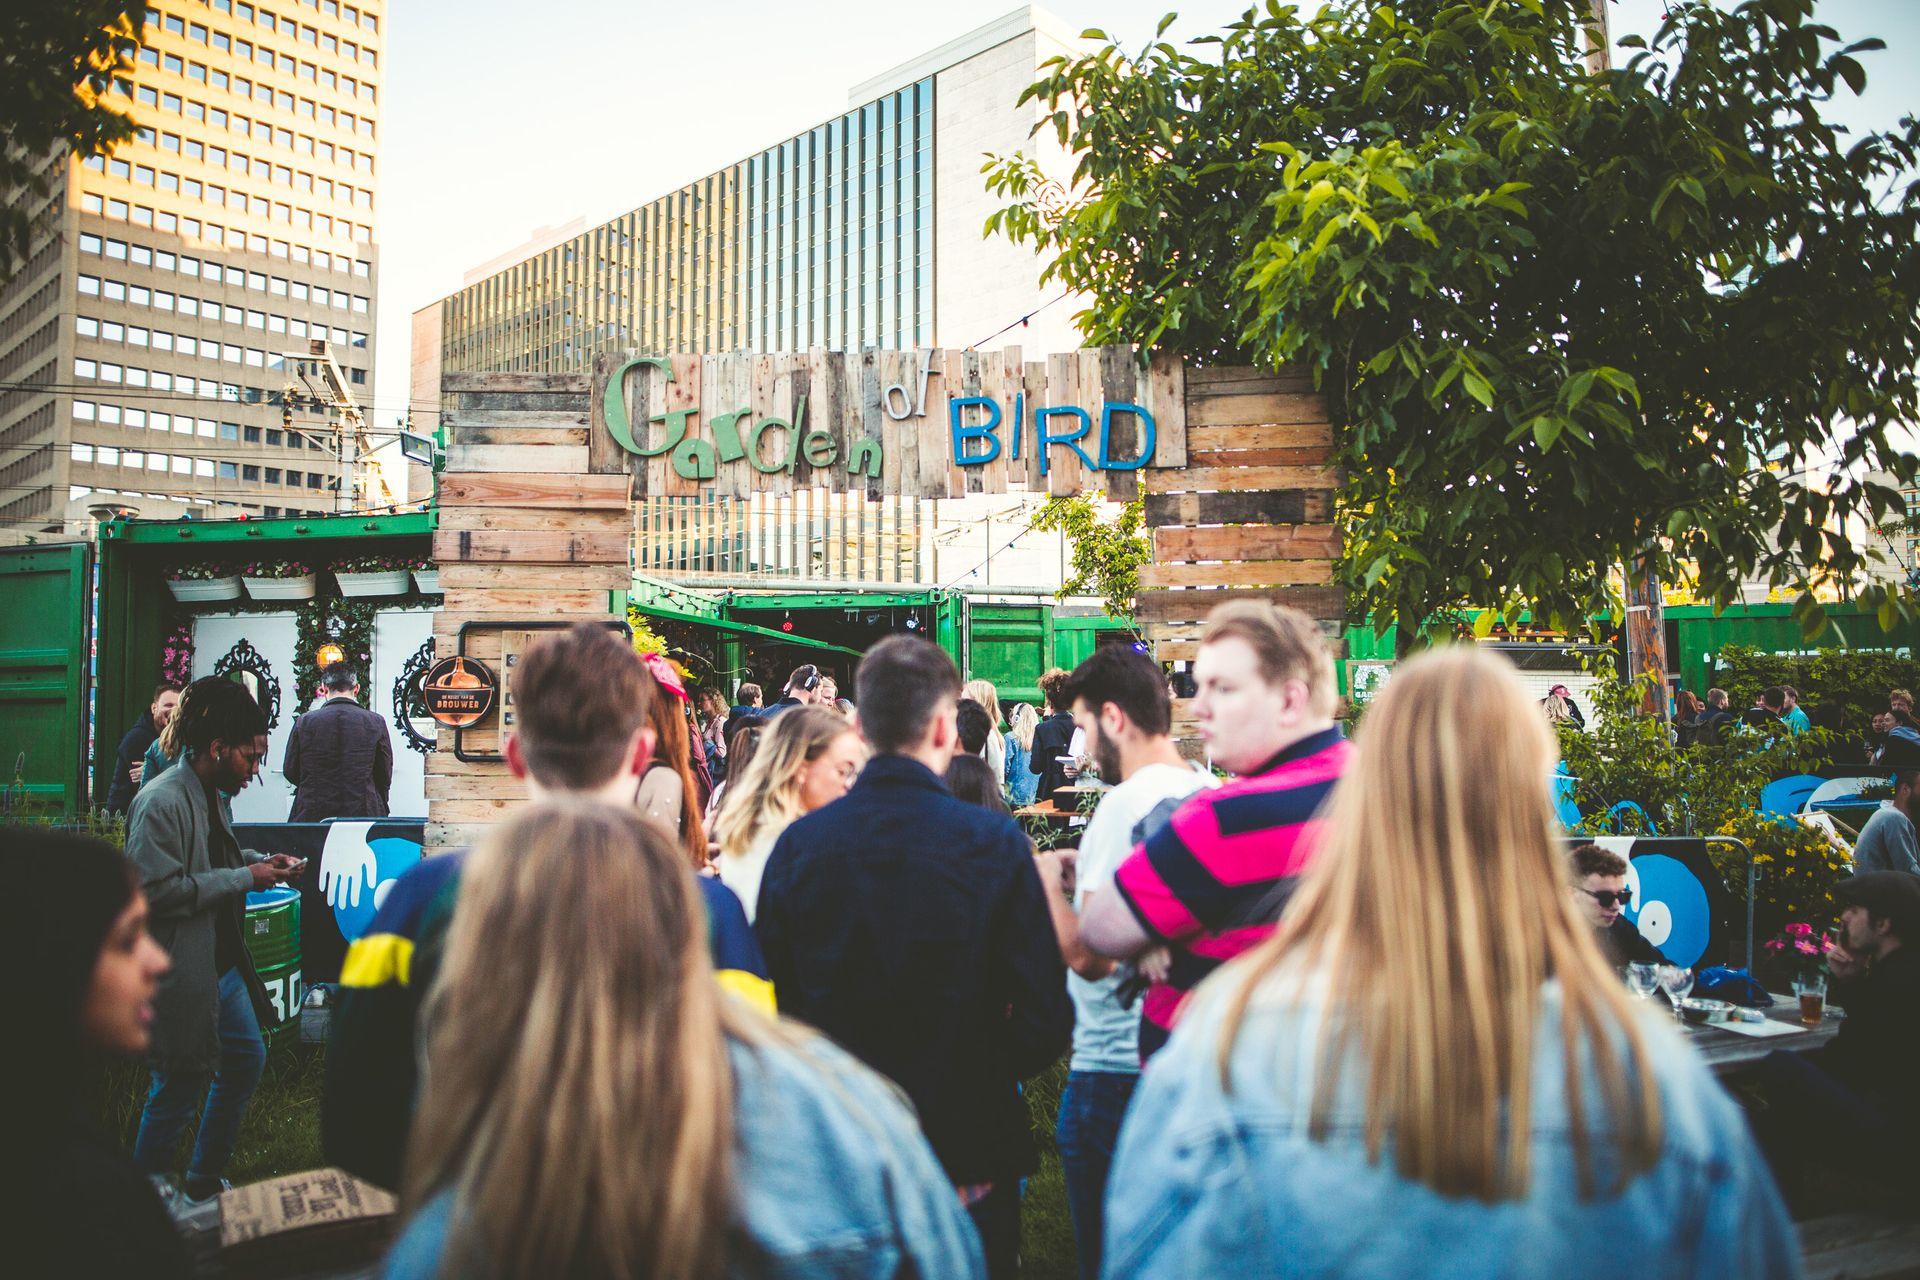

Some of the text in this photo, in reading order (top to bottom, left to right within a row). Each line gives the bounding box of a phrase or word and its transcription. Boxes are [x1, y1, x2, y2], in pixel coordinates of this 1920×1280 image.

[604, 347, 1157, 480] Garden of BIRD
[437, 700, 479, 708] BROUWER
[264, 969, 301, 1022] RD
